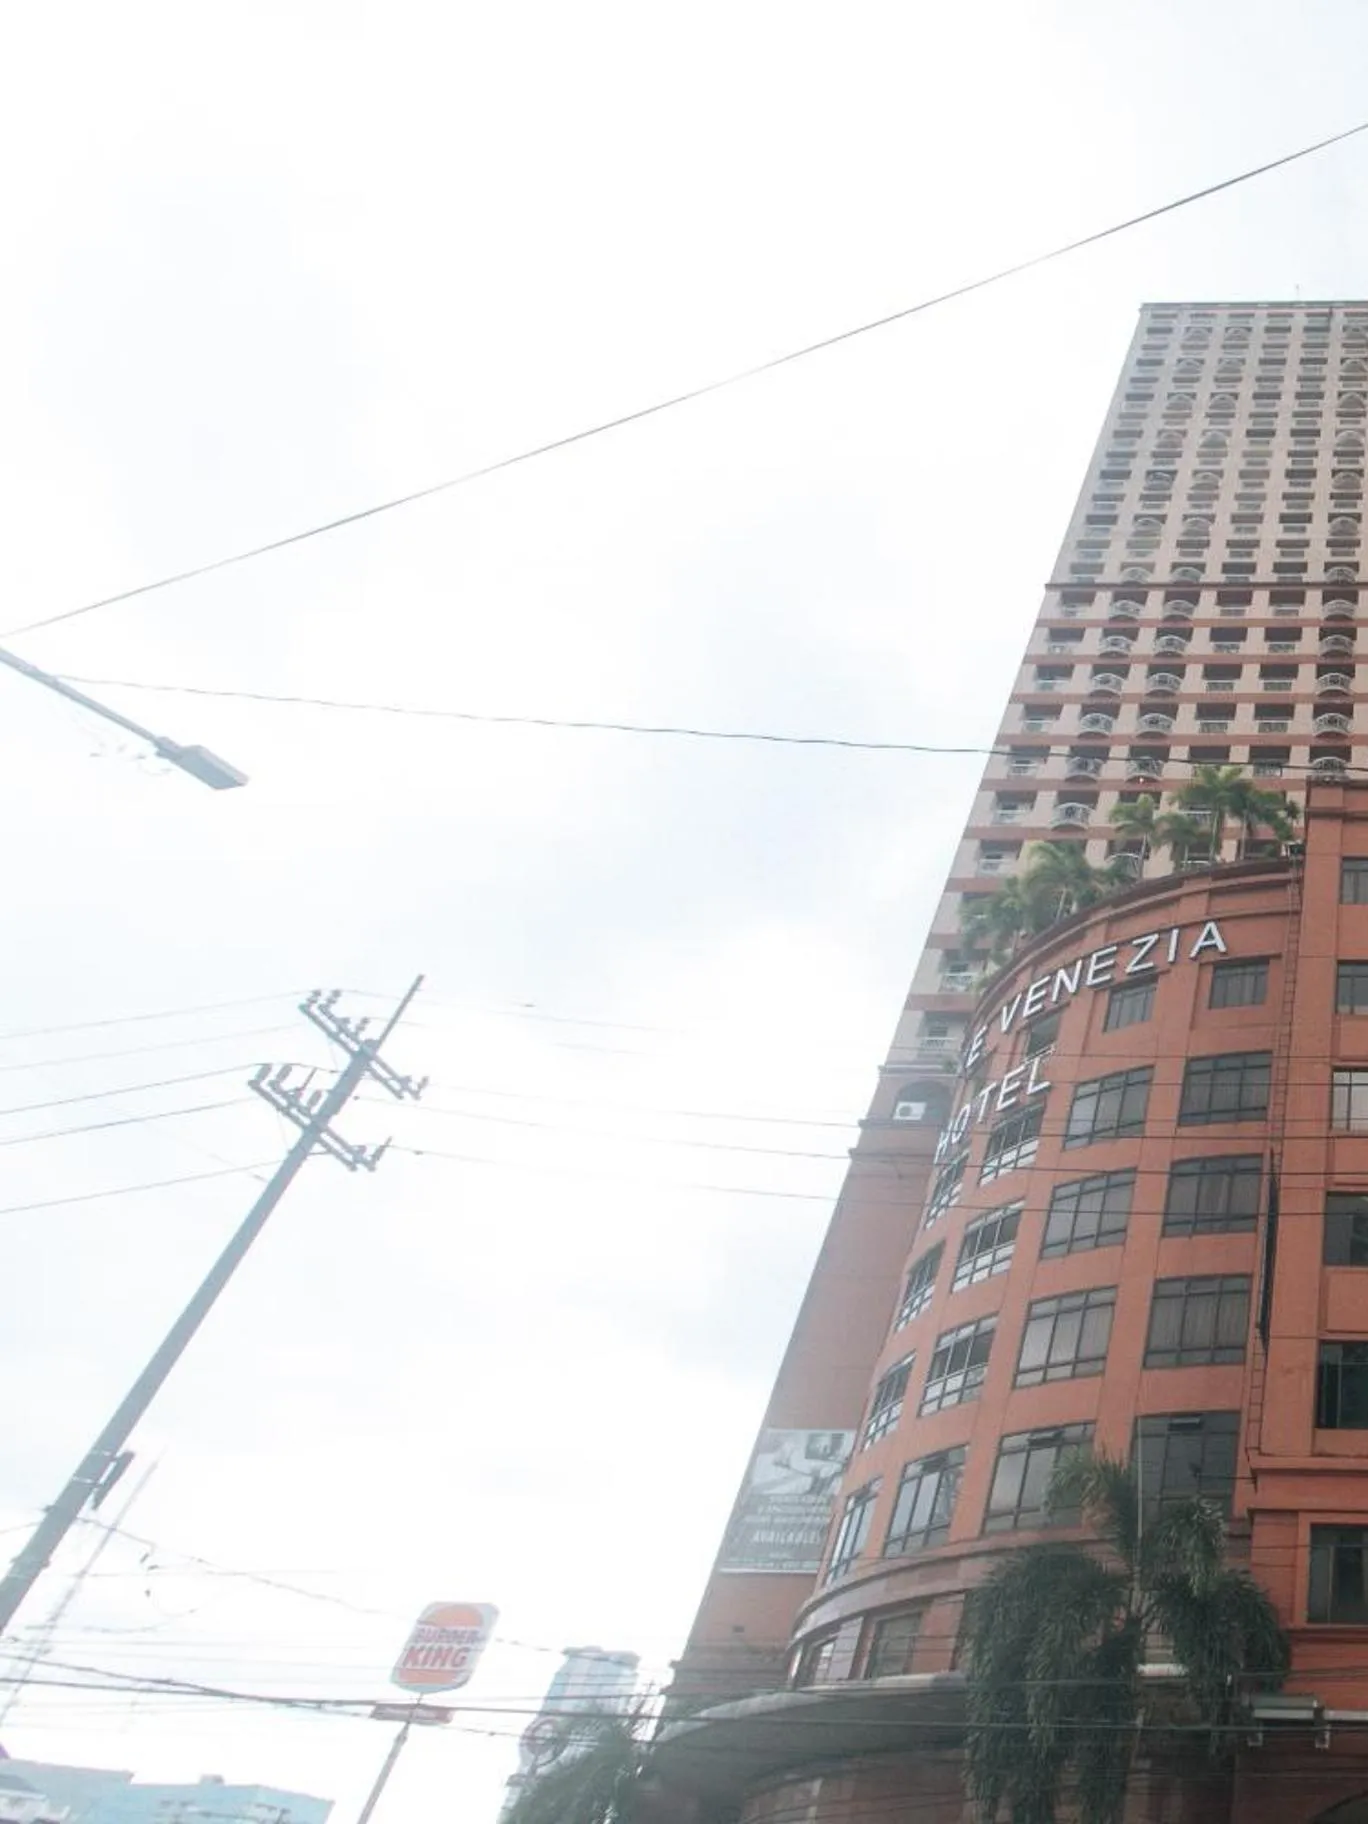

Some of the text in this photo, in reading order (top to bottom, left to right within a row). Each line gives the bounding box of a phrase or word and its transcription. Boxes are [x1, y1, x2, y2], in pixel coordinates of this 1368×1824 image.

[1000, 920, 1228, 1034] VENEZIA
[933, 1056, 1052, 1165] HOTEL
[402, 1645, 471, 1668] KING
